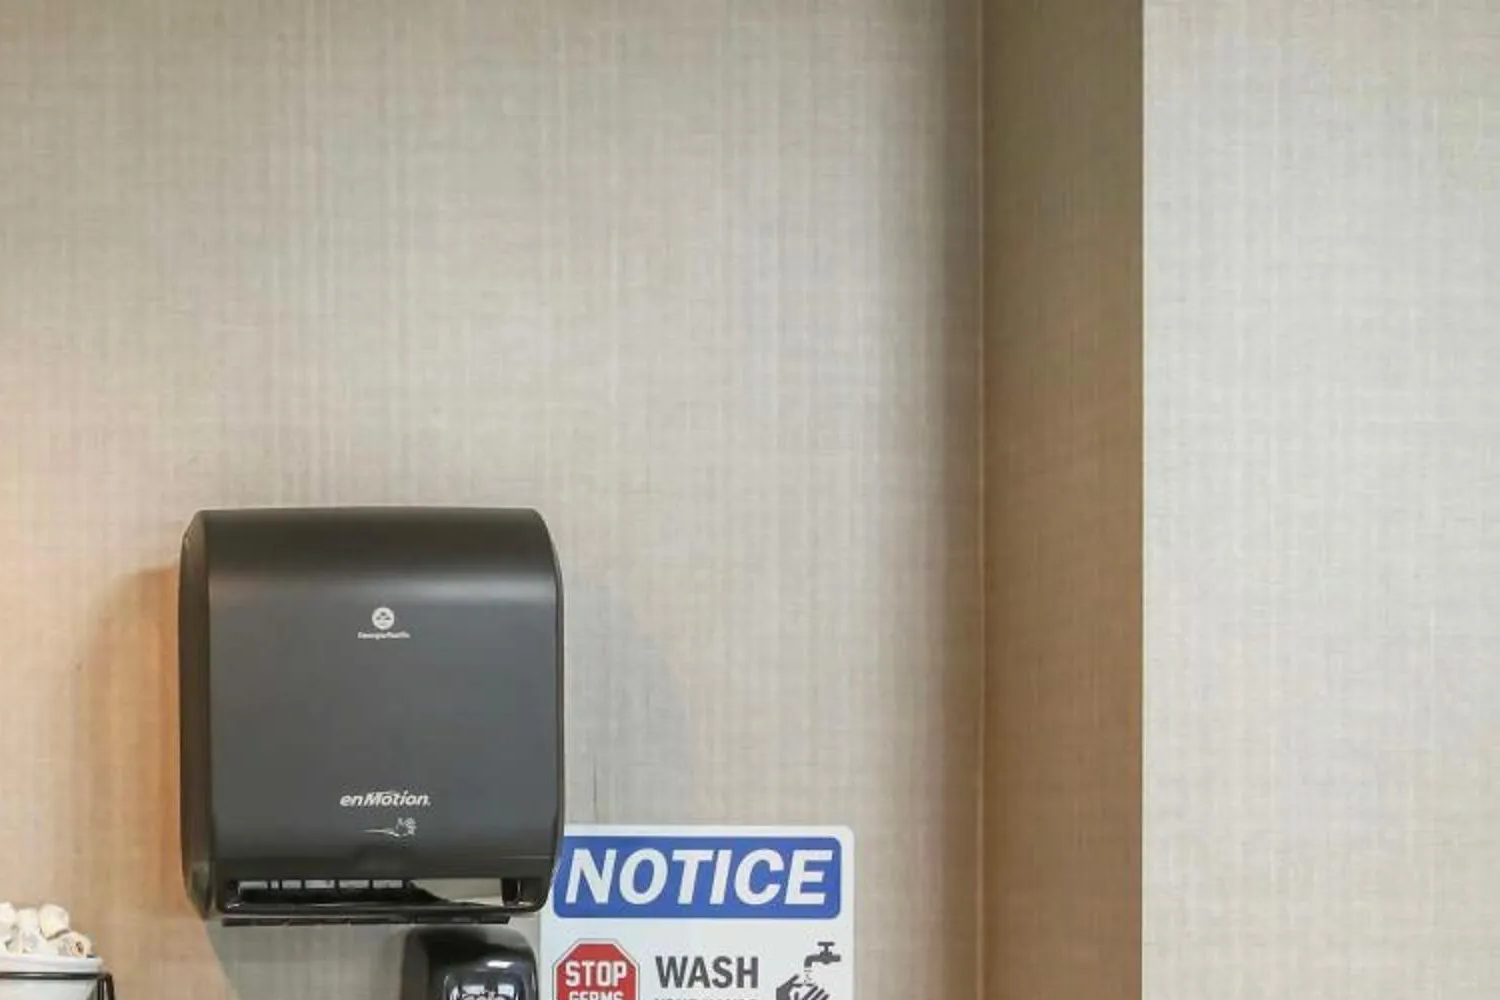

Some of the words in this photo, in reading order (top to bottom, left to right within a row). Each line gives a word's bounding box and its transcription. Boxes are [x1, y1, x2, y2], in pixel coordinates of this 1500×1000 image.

[340, 790, 428, 807] enMotion
[565, 848, 833, 905] NOTICE
[565, 960, 626, 987] STOP
[655, 956, 759, 989] WASH
